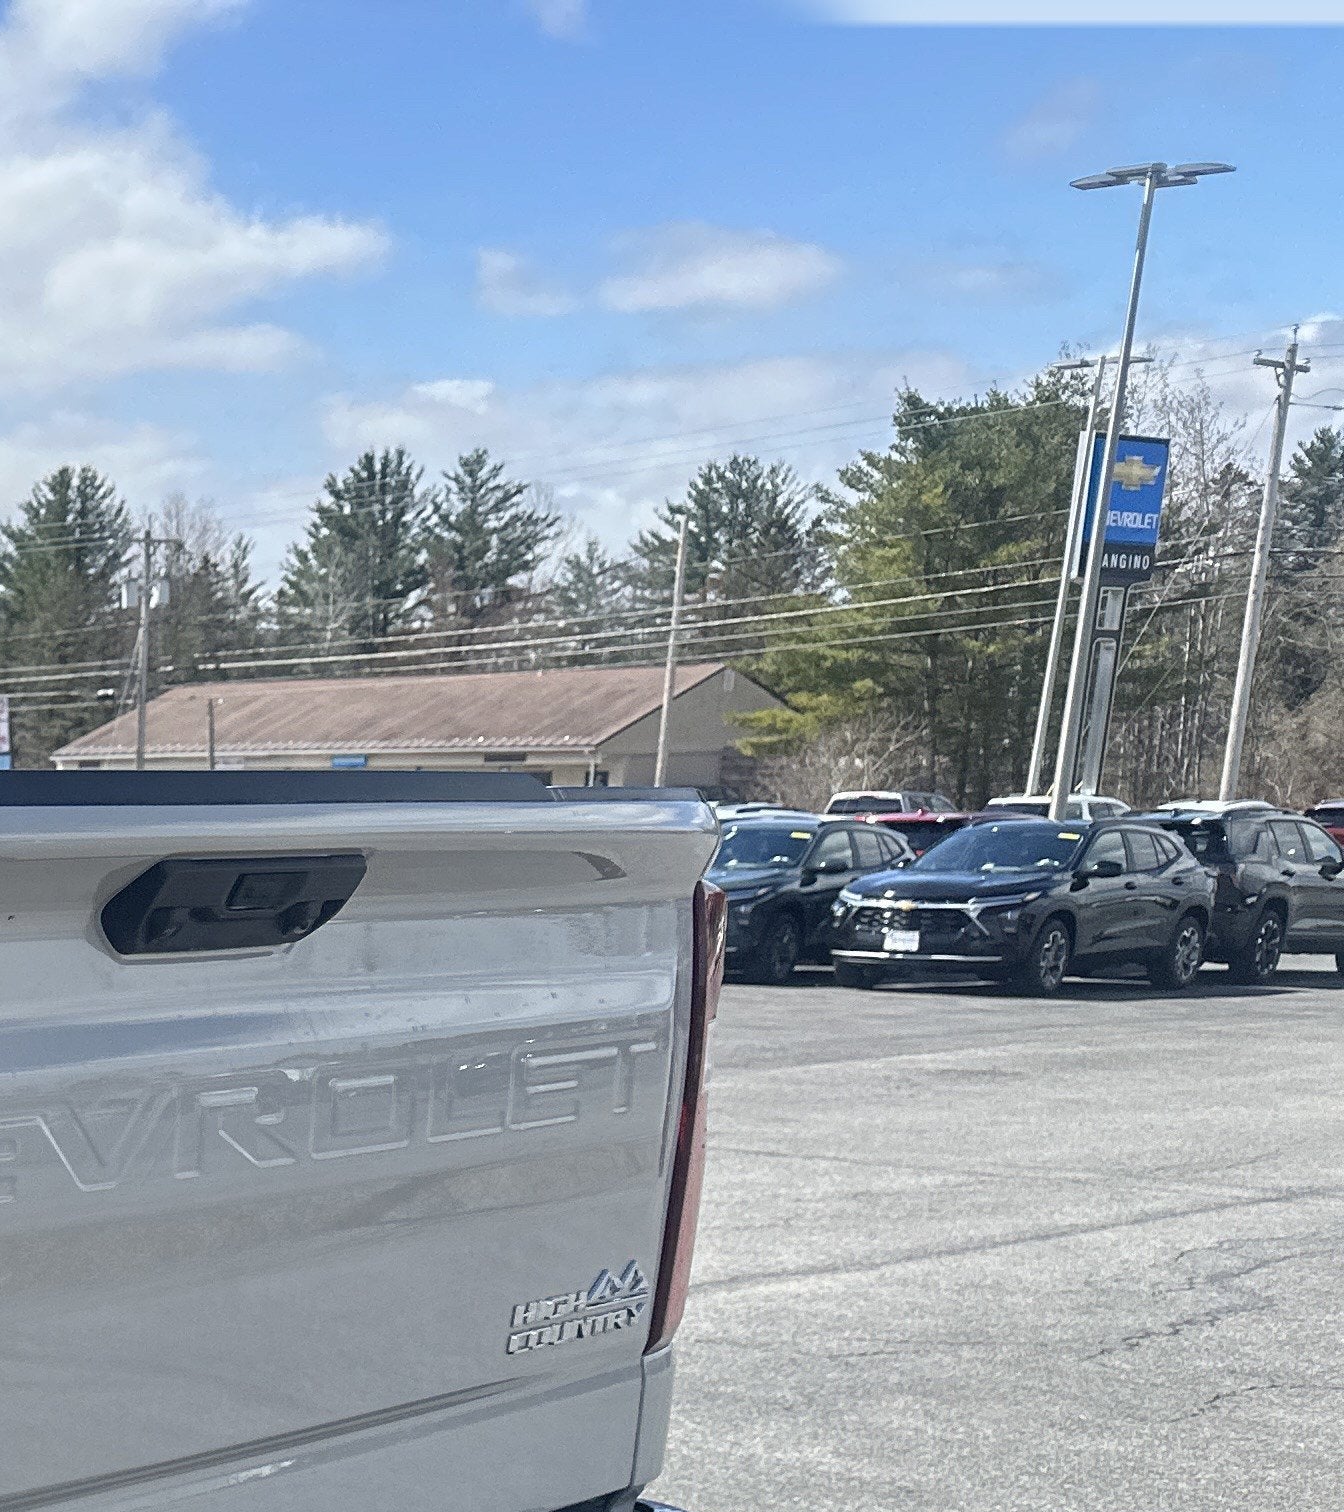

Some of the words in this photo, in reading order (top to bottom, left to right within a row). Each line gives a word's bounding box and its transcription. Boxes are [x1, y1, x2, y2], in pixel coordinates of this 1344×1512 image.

[1106, 510, 1158, 529] EVROLET
[1102, 553, 1150, 570] ANGINO
[511, 1290, 589, 1328] HIGH
[506, 1302, 647, 1355] COUNTRY
